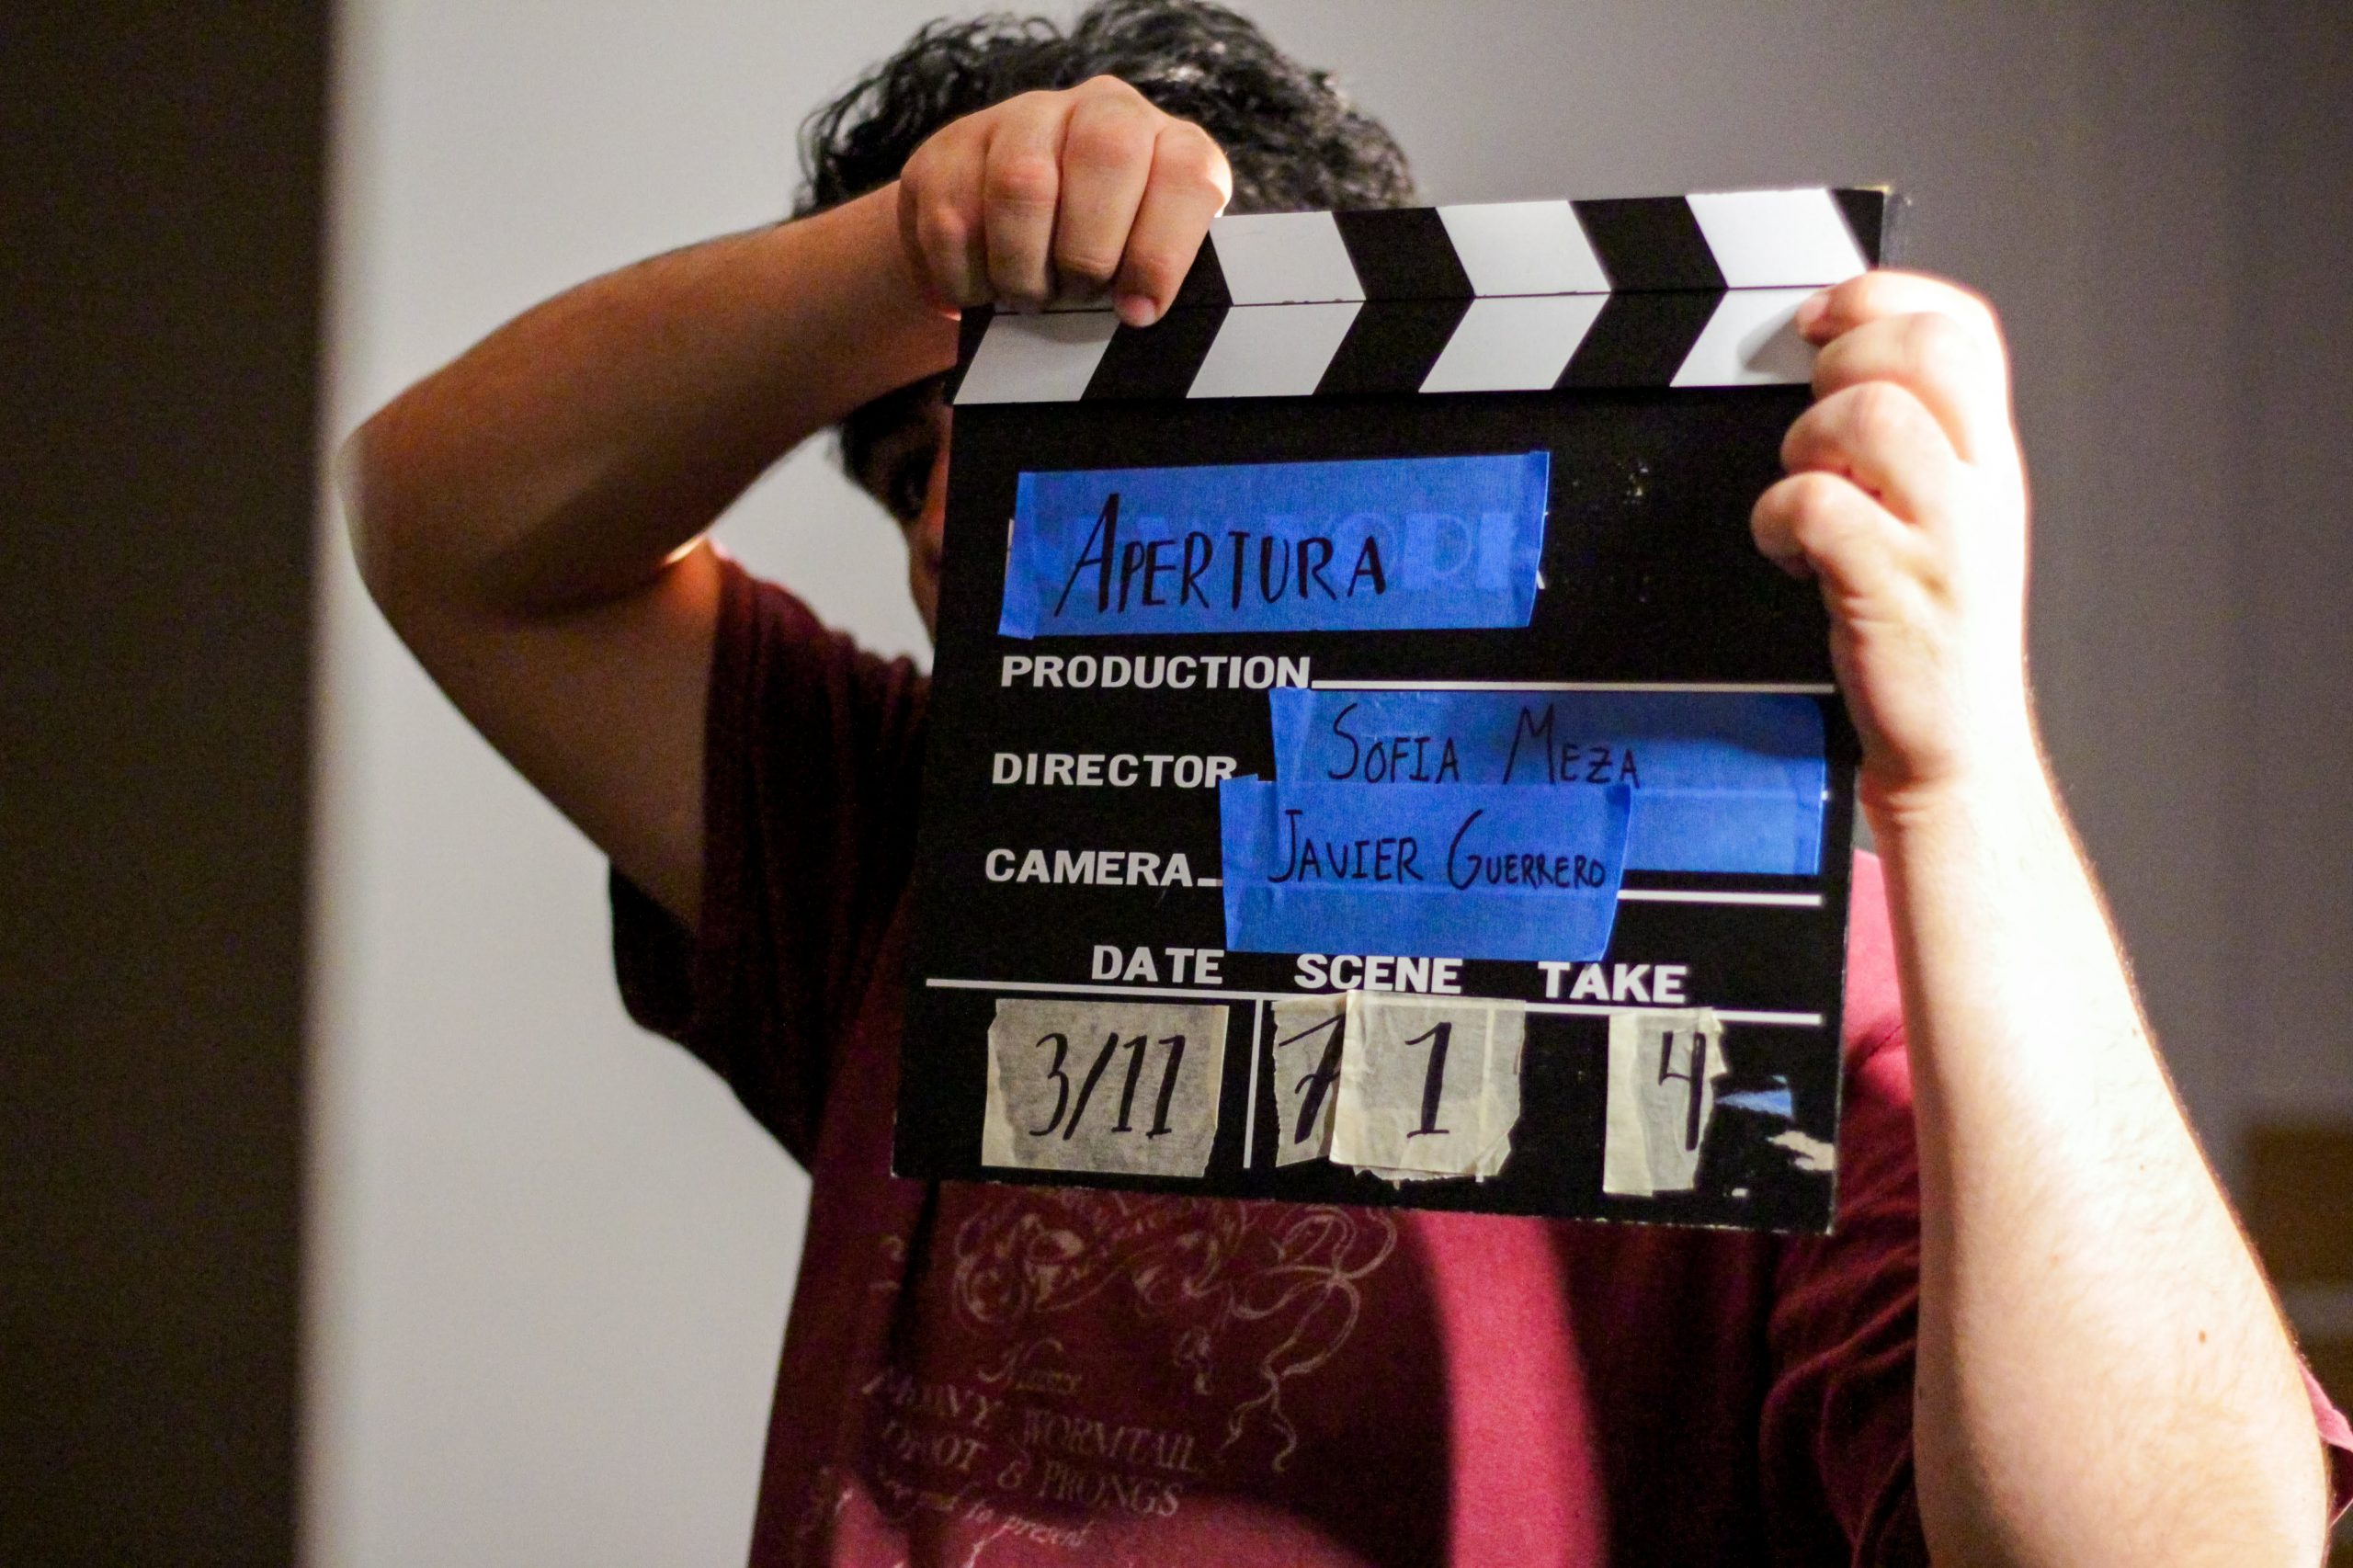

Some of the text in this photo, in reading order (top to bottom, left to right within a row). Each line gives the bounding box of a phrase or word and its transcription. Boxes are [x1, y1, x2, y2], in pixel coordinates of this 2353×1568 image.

[1054, 493, 1388, 617] APERTURA
[1000, 655, 1312, 690] PRODUCTION
[992, 754, 1238, 789] DIRECTOR
[1327, 702, 1641, 789] SOFIA MEZA
[985, 848, 1194, 886] CAMERA
[1267, 809, 1606, 891] JAVIER GUERRERO
[1091, 944, 1225, 985] DATE
[1293, 952, 1463, 994] SCENE
[1538, 960, 1688, 1004] TAKE
[1029, 1032, 1187, 1141] 3/11
[1404, 1021, 1453, 1139] 1
[1659, 1029, 1707, 1152] 4
